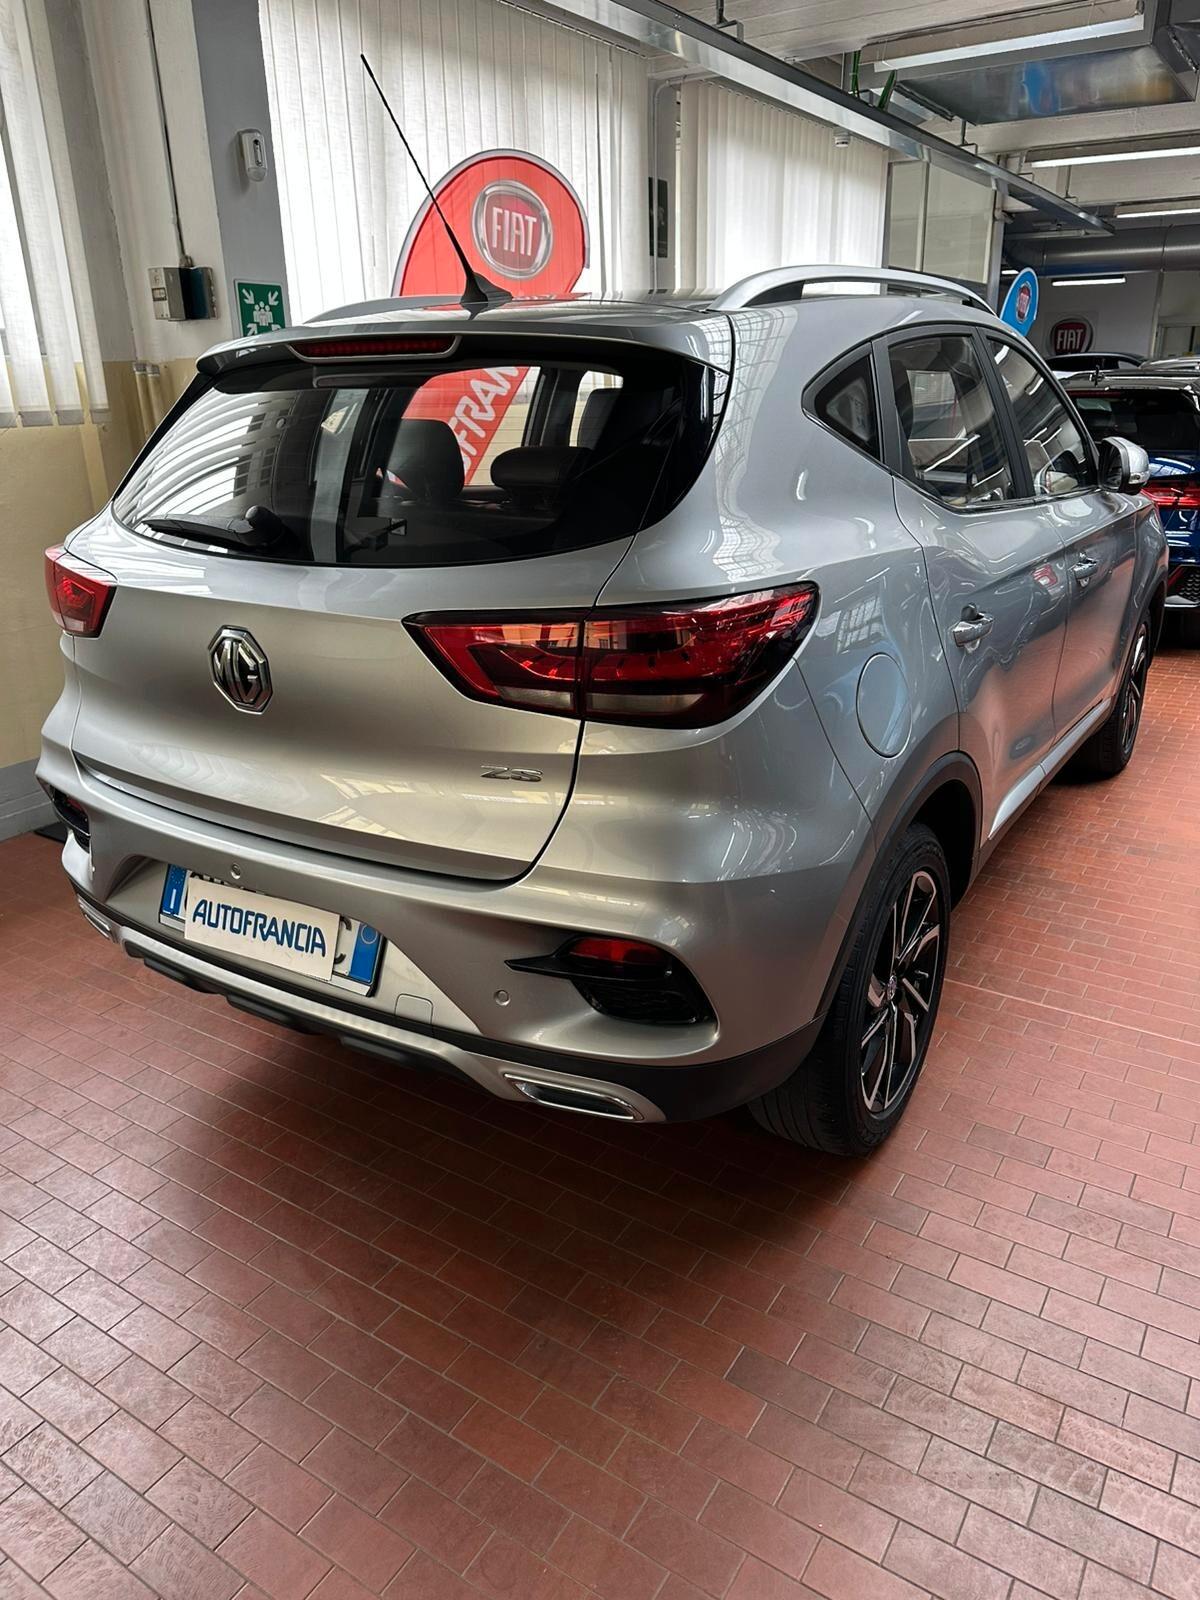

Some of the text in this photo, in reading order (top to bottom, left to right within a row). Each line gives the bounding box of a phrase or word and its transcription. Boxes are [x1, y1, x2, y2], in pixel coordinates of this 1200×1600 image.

[491, 206, 538, 257] FIAT
[1056, 328, 1084, 350] FIAT
[212, 637, 259, 705] MG
[480, 765, 543, 783] ZS
[192, 899, 327, 958] AUTOFRANCIA
